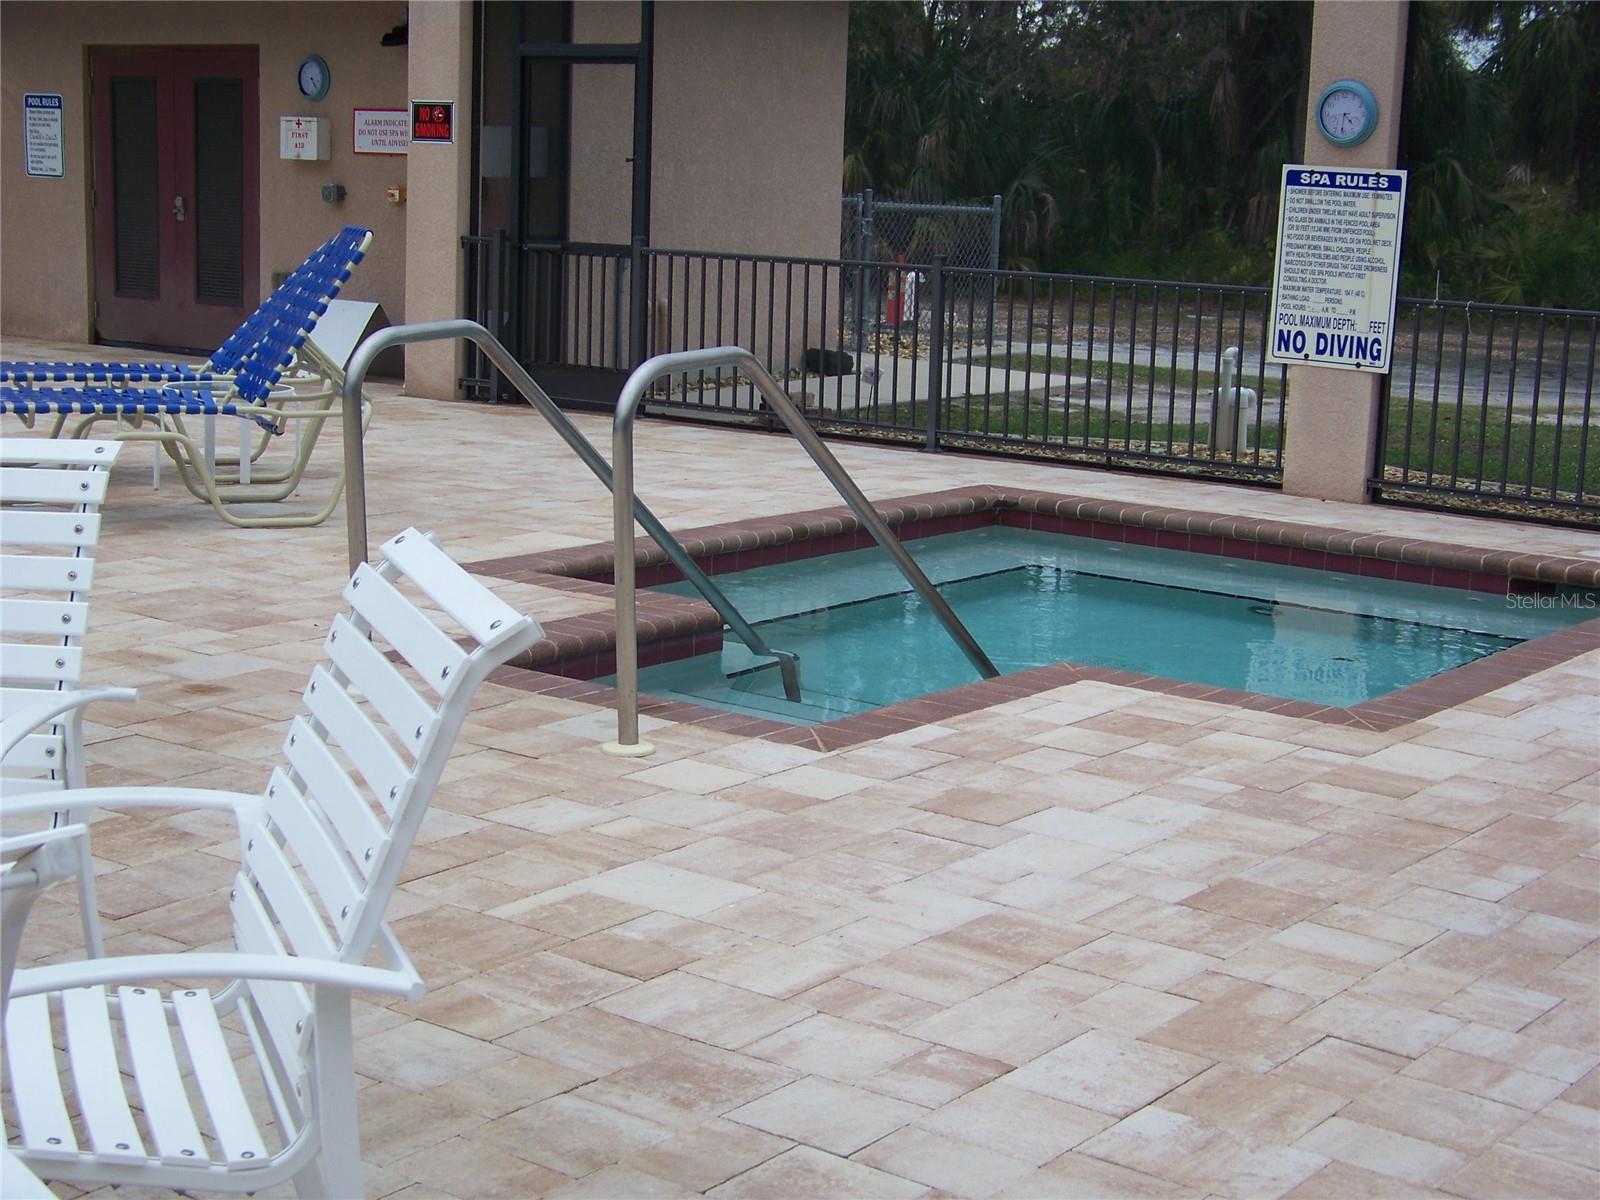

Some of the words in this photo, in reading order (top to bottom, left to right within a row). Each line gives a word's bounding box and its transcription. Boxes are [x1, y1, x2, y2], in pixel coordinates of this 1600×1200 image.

[28, 98, 42, 106] POOL
[42, 98, 59, 106] RULES
[420, 106, 430, 119] NO
[416, 123, 449, 137] SMOKING
[1300, 172, 1330, 185] SPA
[1336, 174, 1389, 188] RULES
[1279, 312, 1298, 326] POOL
[1300, 314, 1332, 329] MAXIMUM
[1332, 318, 1357, 332] DEPTH:
[1368, 321, 1386, 334] FEET
[1278, 329, 1306, 354] NO
[1316, 332, 1382, 361] DIVING
